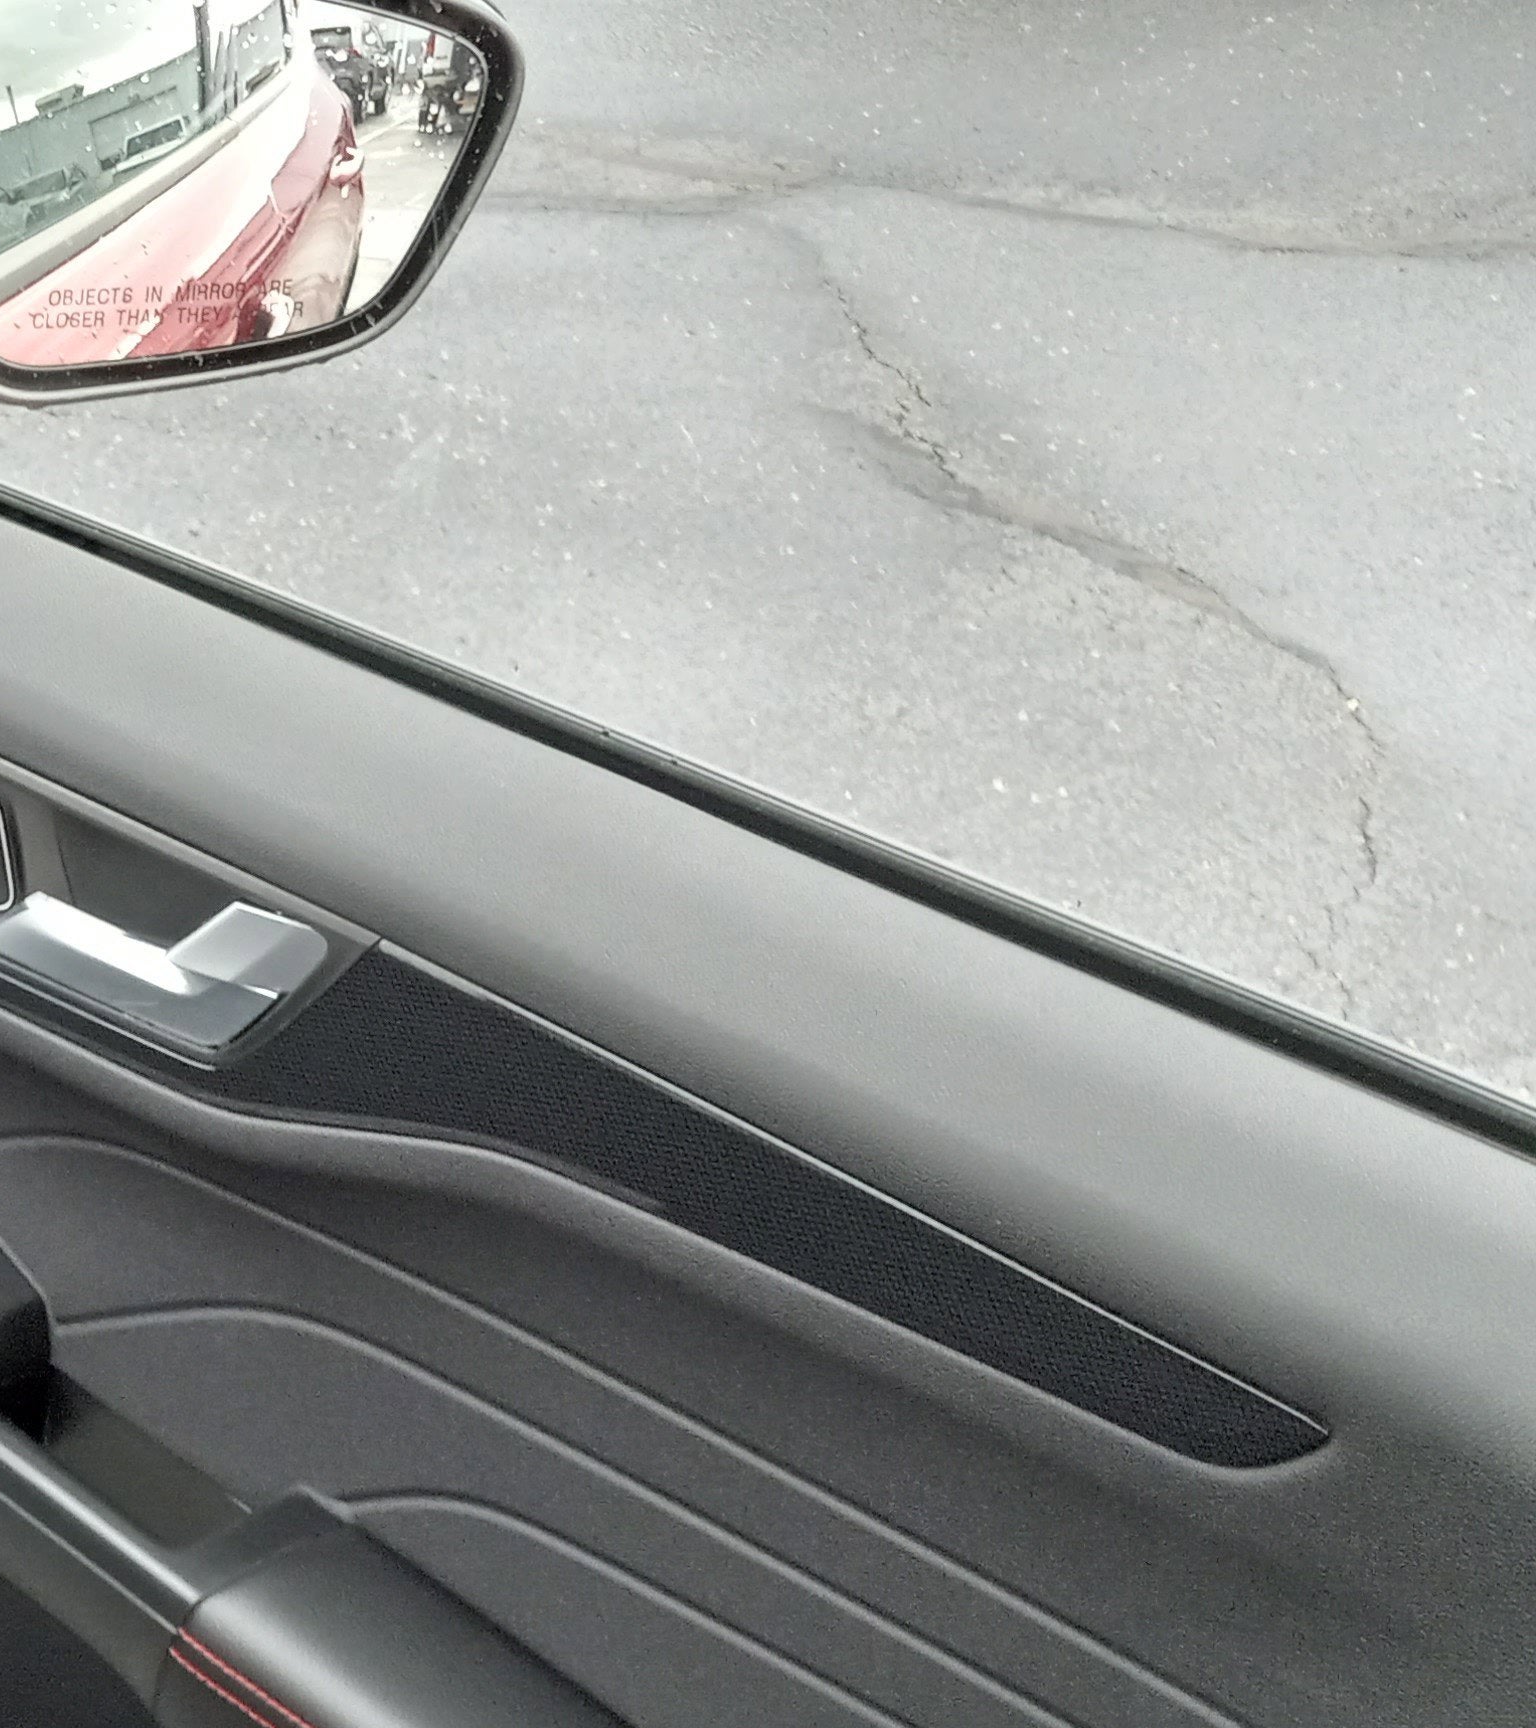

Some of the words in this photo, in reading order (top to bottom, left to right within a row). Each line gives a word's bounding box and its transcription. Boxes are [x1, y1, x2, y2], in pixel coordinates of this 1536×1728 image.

[48, 287, 134, 307] OBJECTS
[145, 286, 163, 303] IN
[177, 280, 245, 301] MIRROR
[257, 278, 294, 296] ARE
[32, 310, 106, 329] CLOSER
[177, 305, 228, 324] THEY
